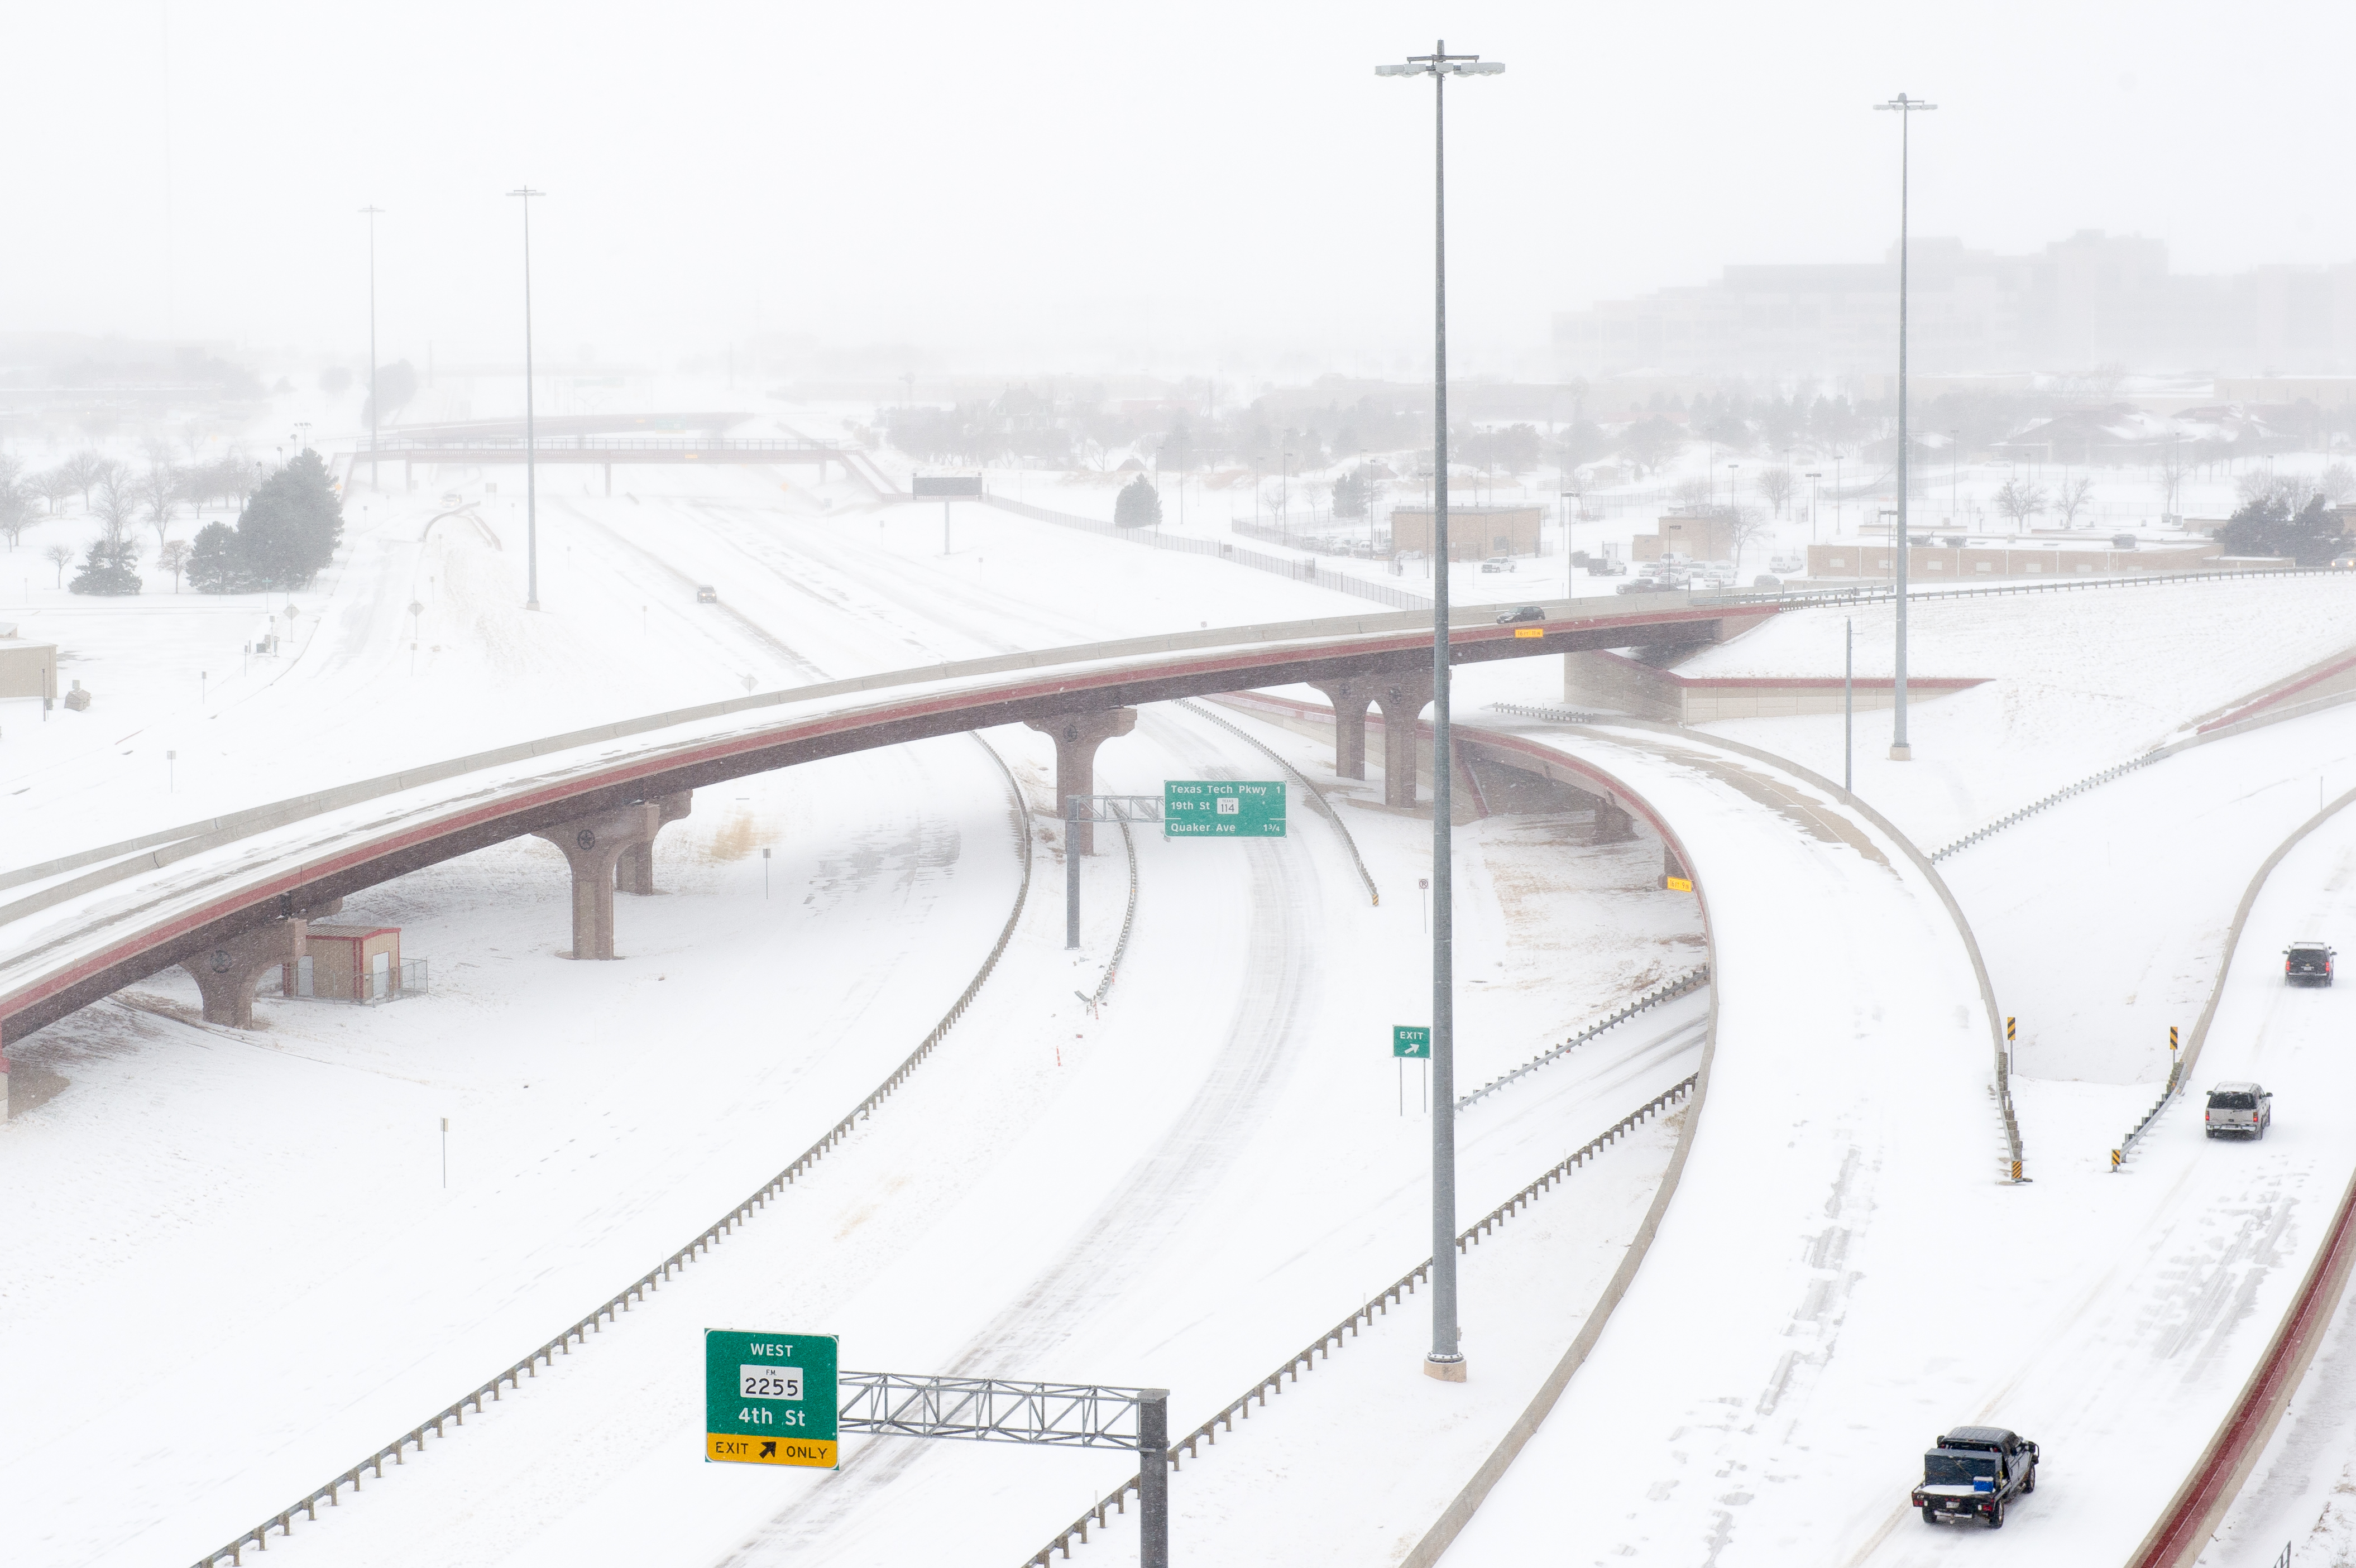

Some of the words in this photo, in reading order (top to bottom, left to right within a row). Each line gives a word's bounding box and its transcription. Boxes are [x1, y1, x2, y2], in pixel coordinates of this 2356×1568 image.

[1171, 785, 1202, 794] Texas
[1207, 785, 1233, 794] Tech
[1239, 785, 1267, 796] Pkwy
[1171, 802, 1194, 810] 19th
[1199, 802, 1210, 810] St
[1221, 804, 1234, 812] 114
[1171, 823, 1211, 832] Quaker
[1216, 823, 1236, 832] Ave
[1400, 1031, 1424, 1040] EXIT
[750, 1342, 793, 1357] WEST
[745, 1377, 798, 1397] 2255
[738, 1407, 773, 1424] 4th
[785, 1409, 806, 1426] St
[716, 1441, 749, 1454] EXIT
[786, 1446, 827, 1459] ONLY
